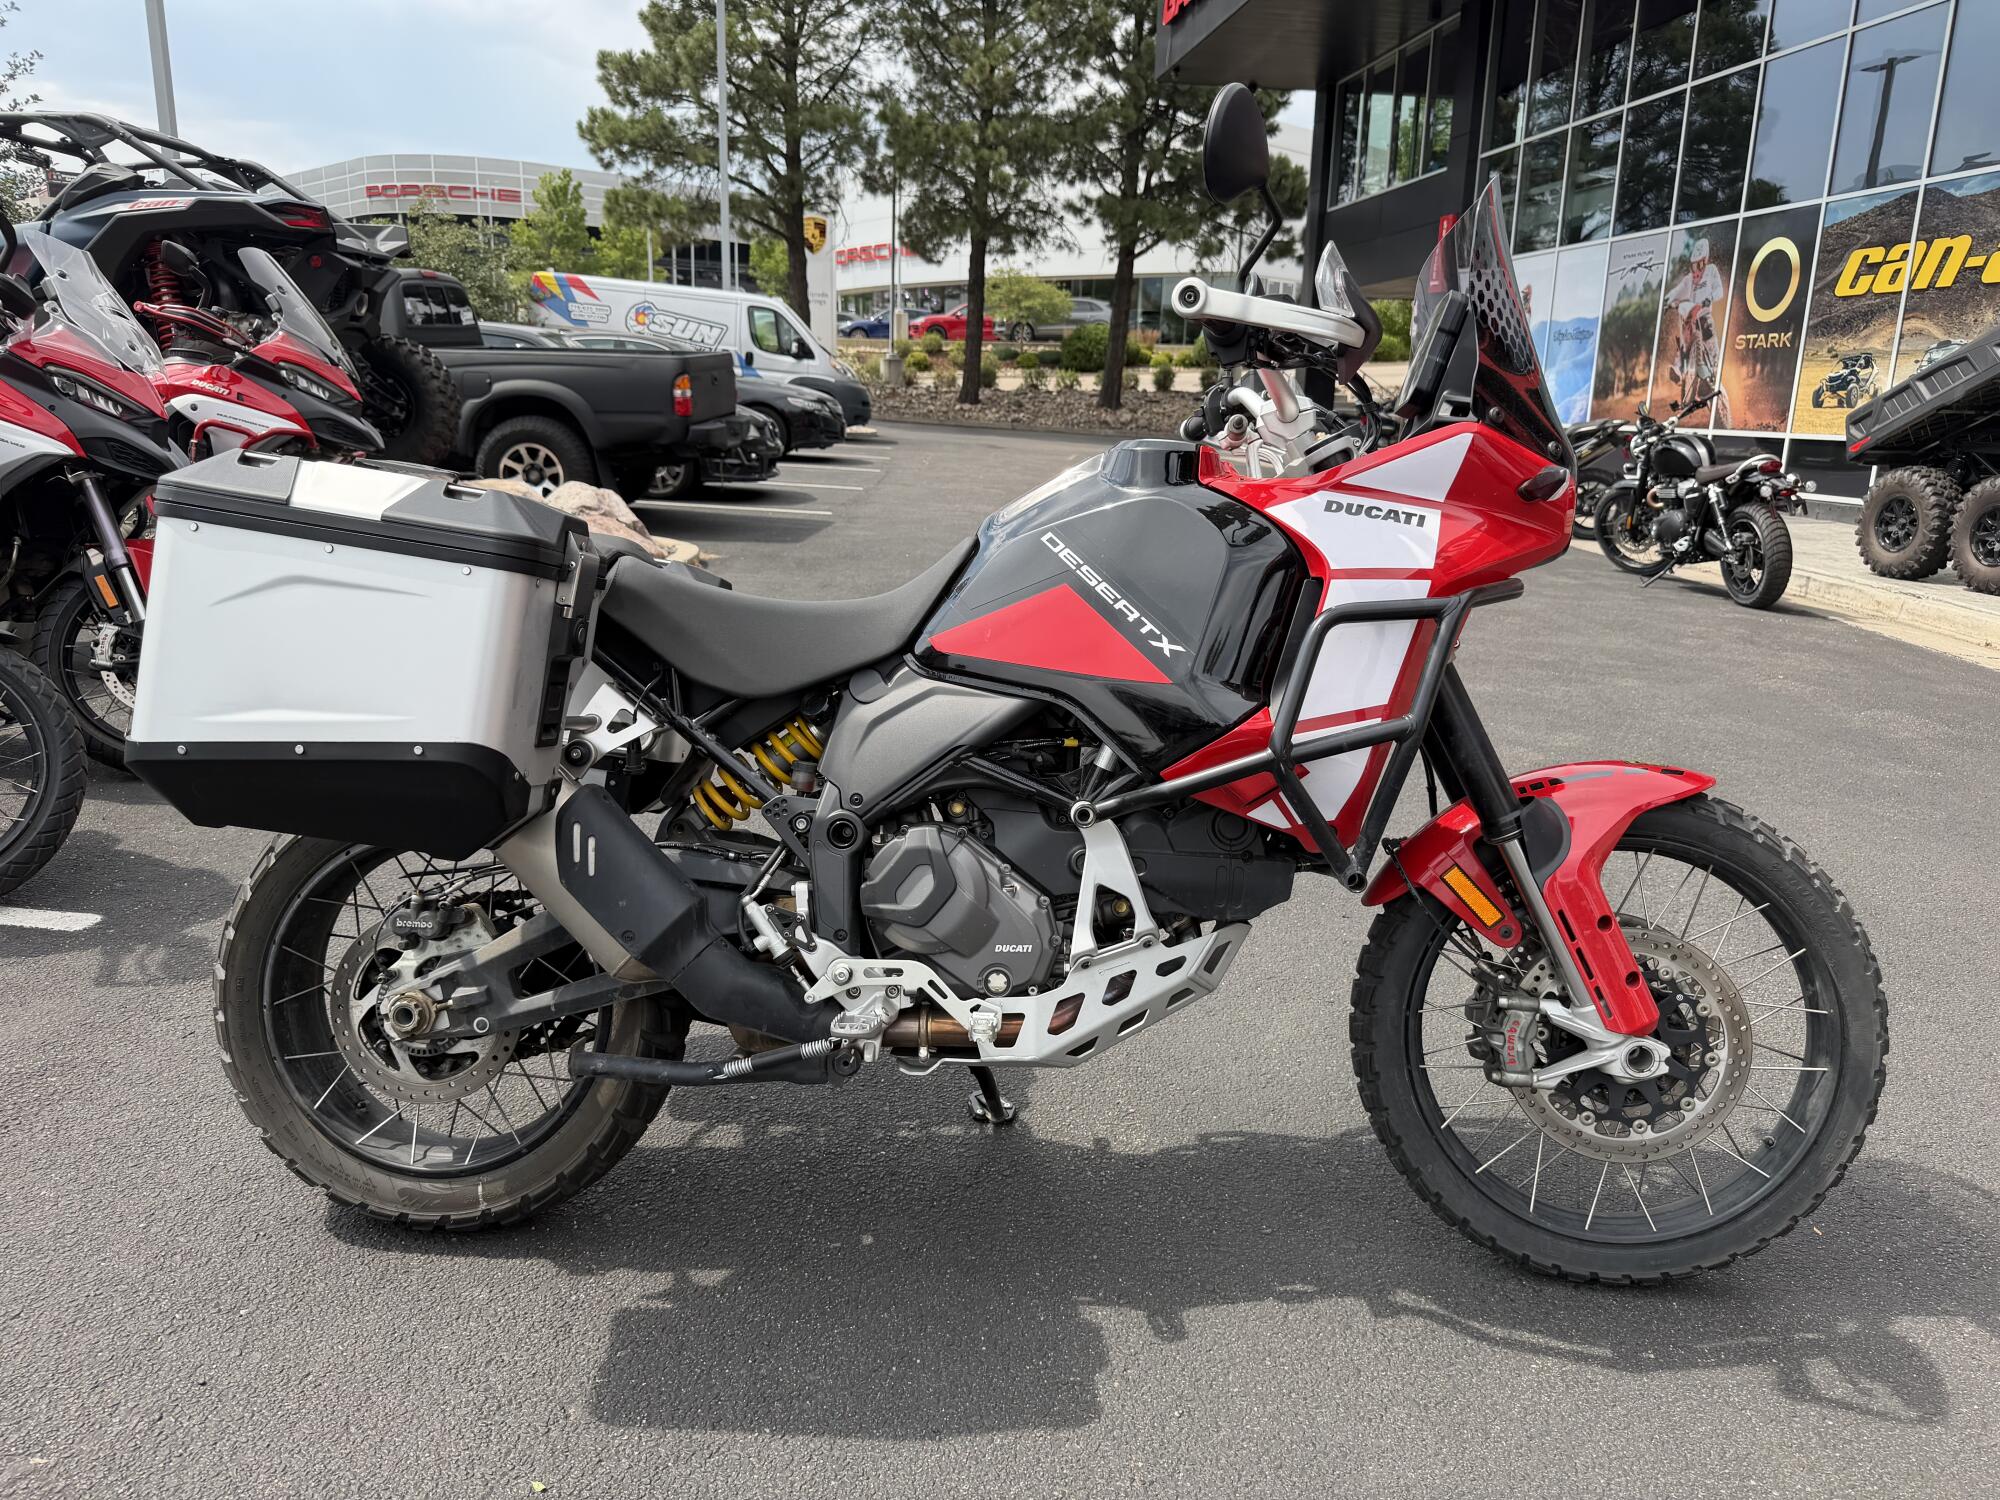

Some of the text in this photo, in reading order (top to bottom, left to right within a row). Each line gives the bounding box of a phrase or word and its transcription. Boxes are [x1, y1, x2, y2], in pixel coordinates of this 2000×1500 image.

[366, 184, 521, 202] PORSCHE
[649, 313, 724, 346] SUN
[1734, 331, 1793, 350] STARK
[190, 379, 230, 396] DUCATI
[1323, 499, 1427, 528] DUCATI
[1040, 531, 1187, 658] DESERTX
[396, 917, 433, 929] brembo
[994, 944, 1033, 953] DUCATI
[1505, 1020, 1521, 1067] brembo
